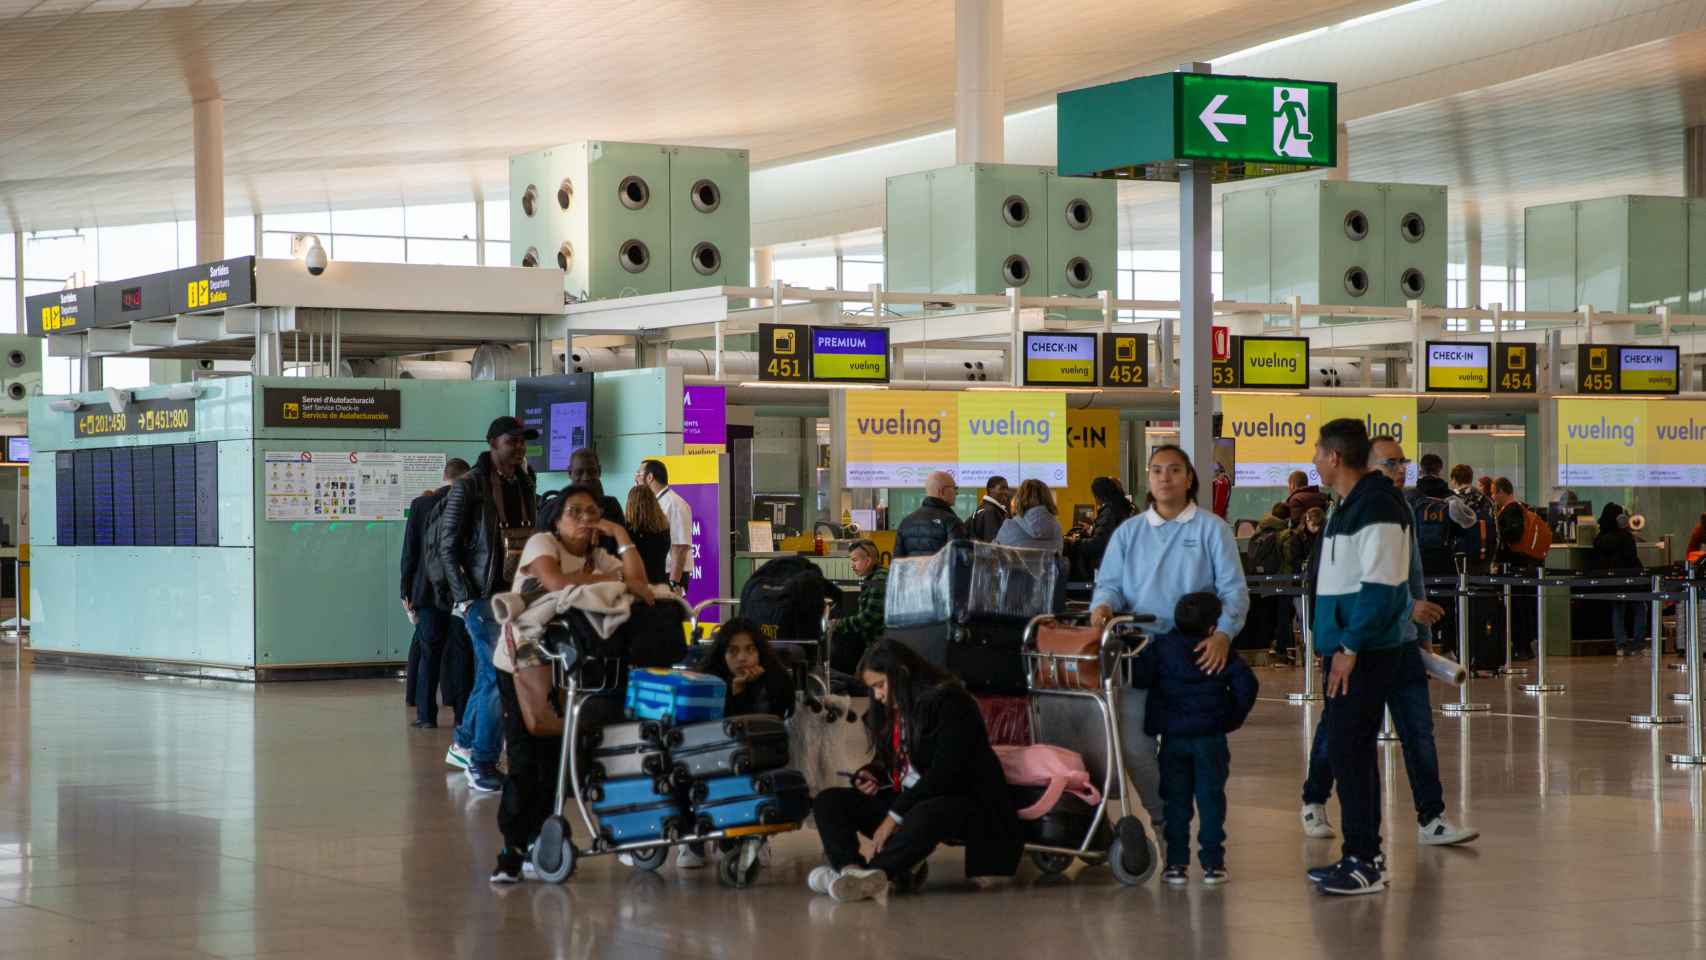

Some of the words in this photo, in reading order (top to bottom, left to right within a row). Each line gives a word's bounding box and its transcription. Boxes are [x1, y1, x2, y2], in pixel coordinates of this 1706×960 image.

[818, 337, 867, 348] PREMIUM
[1031, 342, 1078, 353] CHECK-IN
[1250, 352, 1297, 373] vueling
[1433, 351, 1473, 361] CHECK-IN
[1624, 354, 1663, 364] CHECK-IN
[767, 358, 801, 377] 451
[849, 358, 880, 373] vueling
[1060, 364, 1089, 376] vueling
[1109, 365, 1143, 383] 452
[1213, 367, 1234, 384] 53
[1458, 371, 1484, 383] vueling
[1501, 373, 1532, 389] 454
[1584, 374, 1613, 390] 455
[857, 408, 942, 443] vueling
[968, 410, 1050, 444] vueling
[1232, 413, 1306, 445] vueling
[1567, 415, 1635, 447] vueling
[1656, 417, 1706, 441] vuelin
